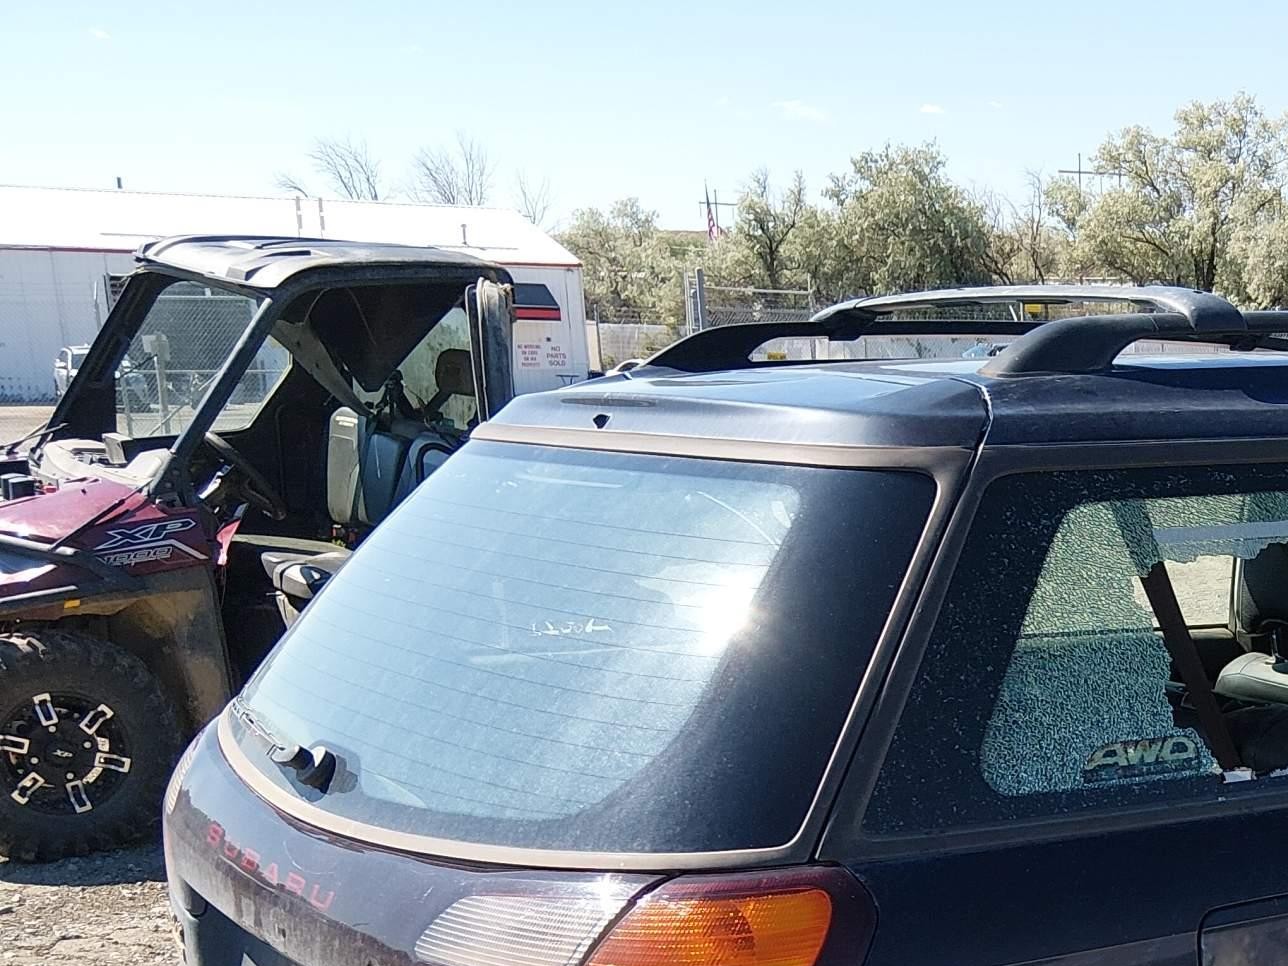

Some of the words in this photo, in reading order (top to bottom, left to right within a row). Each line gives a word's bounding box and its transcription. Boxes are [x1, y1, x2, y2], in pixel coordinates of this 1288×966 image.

[93, 518, 197, 551] XP
[1084, 736, 1200, 770] AWD
[206, 822, 336, 914] SUBARU
